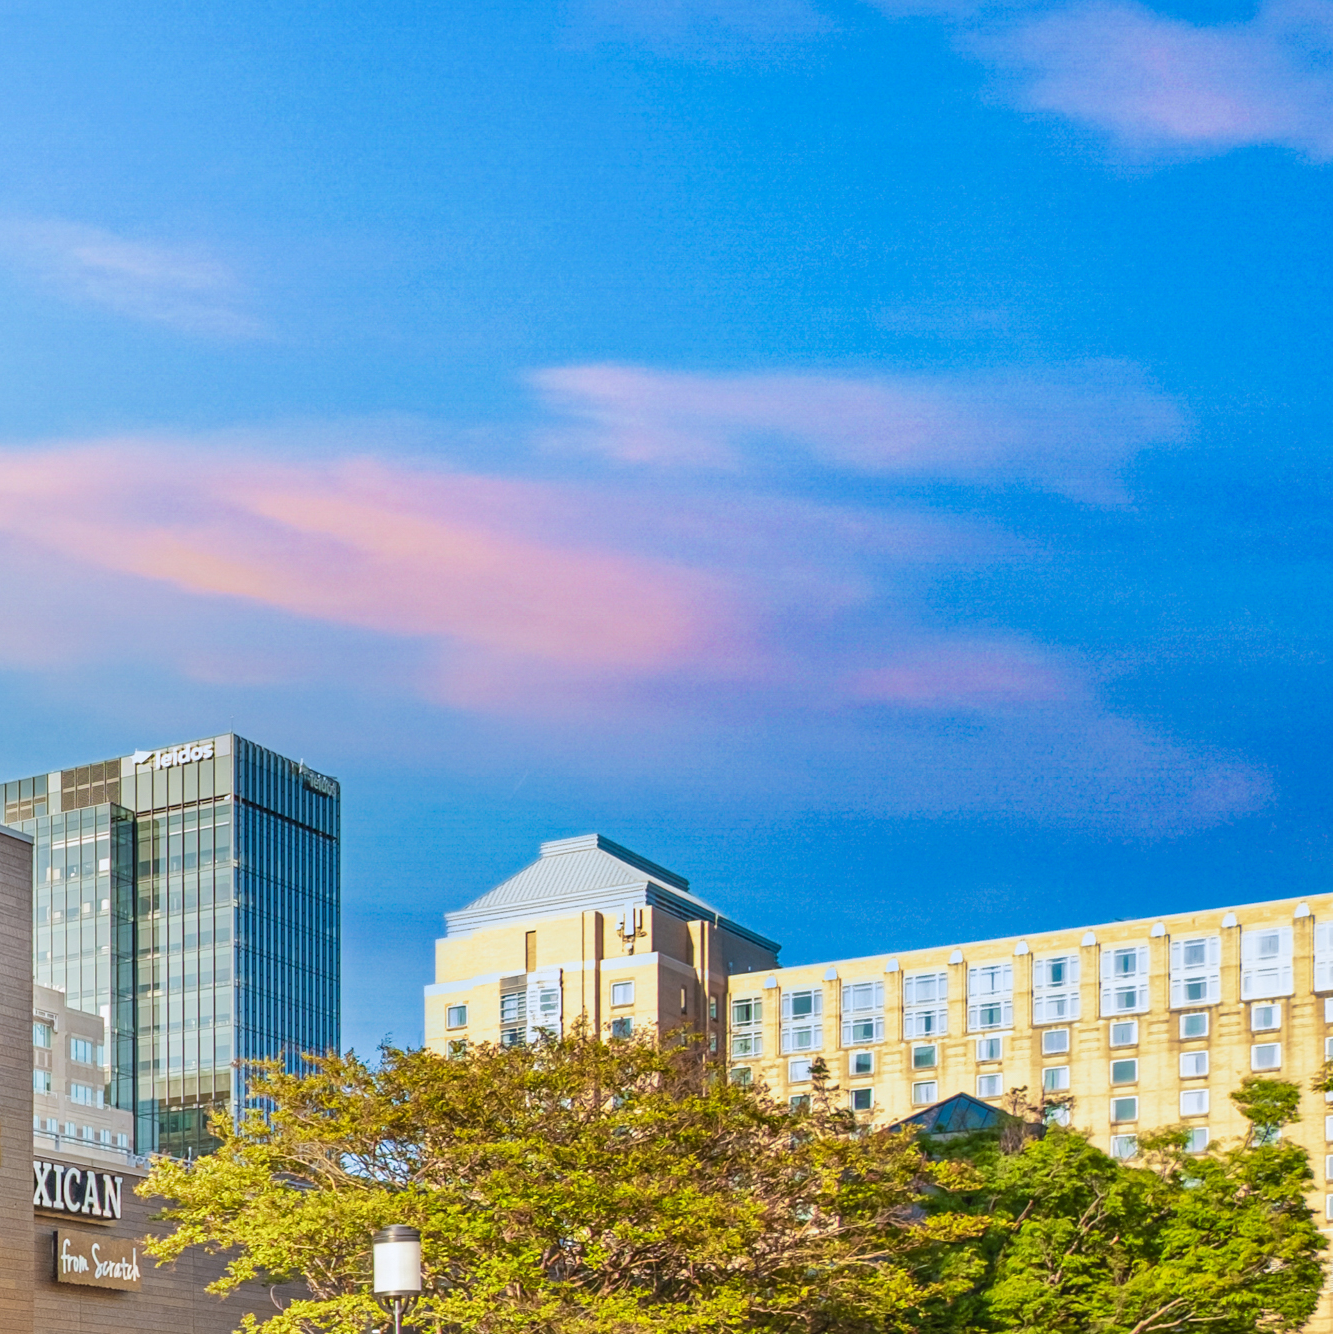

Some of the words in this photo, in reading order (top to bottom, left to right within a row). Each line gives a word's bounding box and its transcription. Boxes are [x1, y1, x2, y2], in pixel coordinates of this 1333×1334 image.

[155, 743, 214, 769] leidos
[33, 1160, 123, 1219] XICAN
[60, 1238, 90, 1274] from
[91, 1242, 141, 1282] Scratch
